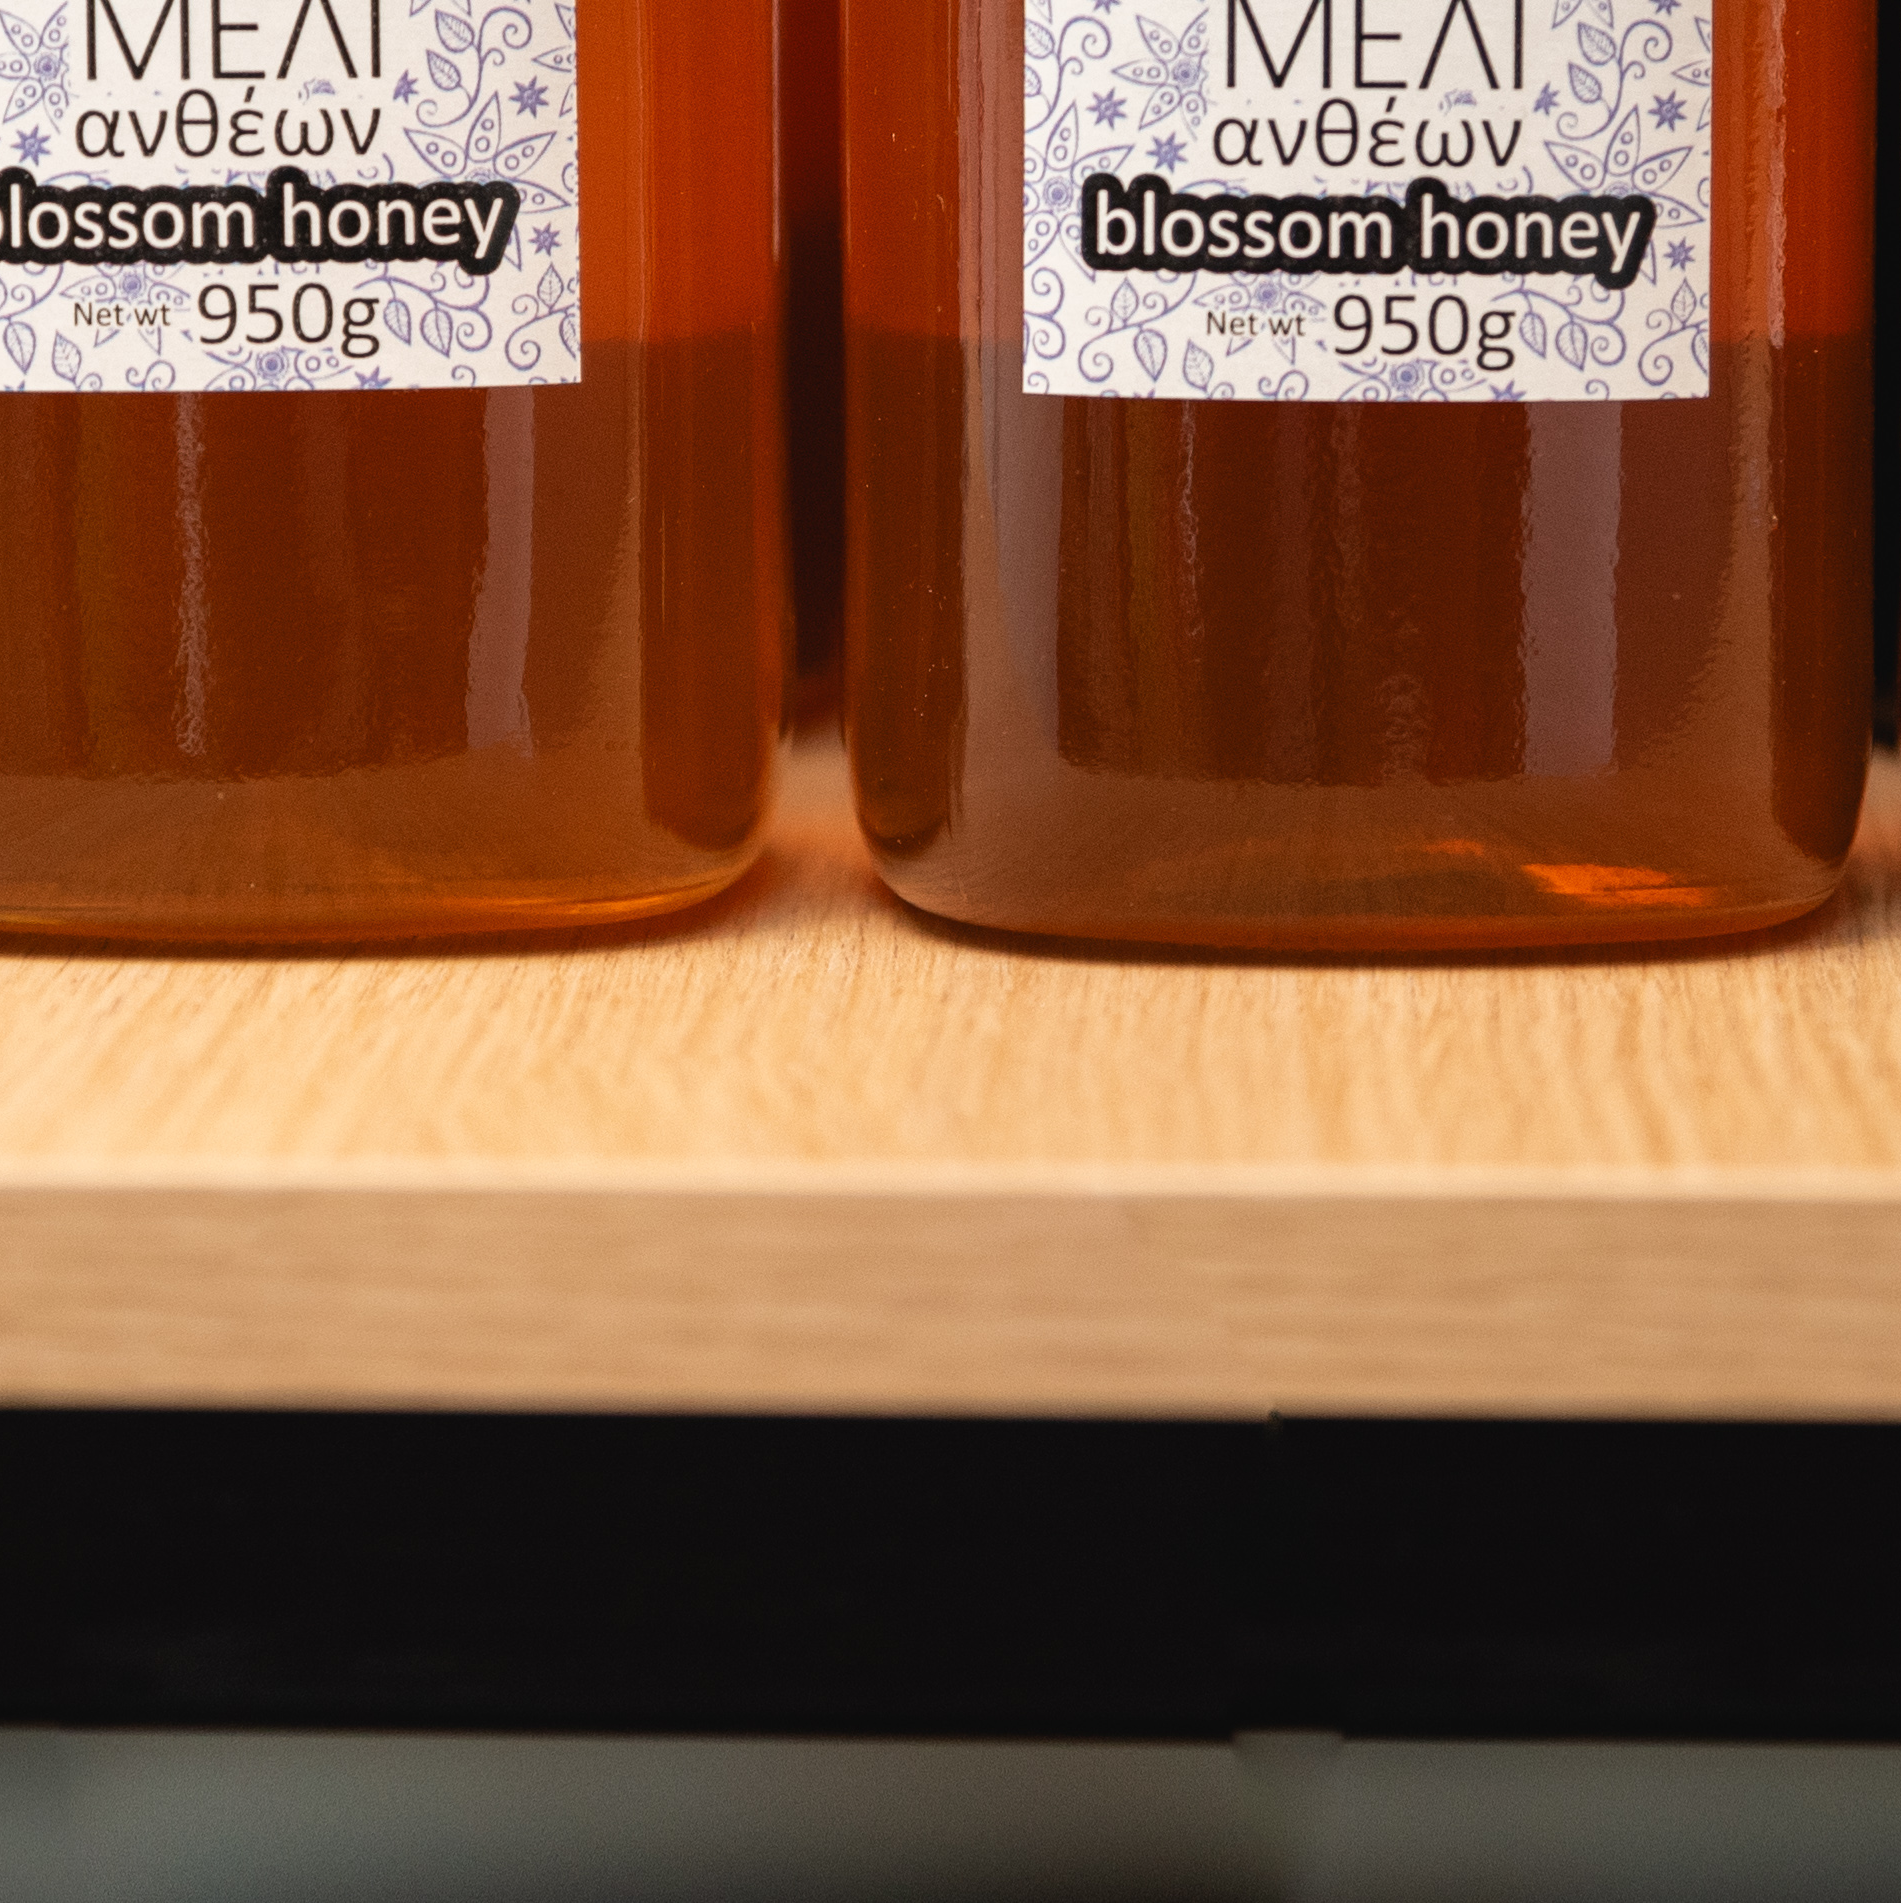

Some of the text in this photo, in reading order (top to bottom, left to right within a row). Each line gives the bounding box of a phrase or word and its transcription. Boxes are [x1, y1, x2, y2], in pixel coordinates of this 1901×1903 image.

[75, 88, 381, 158] ανθέων
[1214, 98, 1522, 168] ανθέων
[282, 185, 504, 259] honey
[1096, 189, 1641, 271] blossom honey
[74, 283, 380, 358] Net wt 950g
[1206, 295, 1515, 370] Net wt 950g
